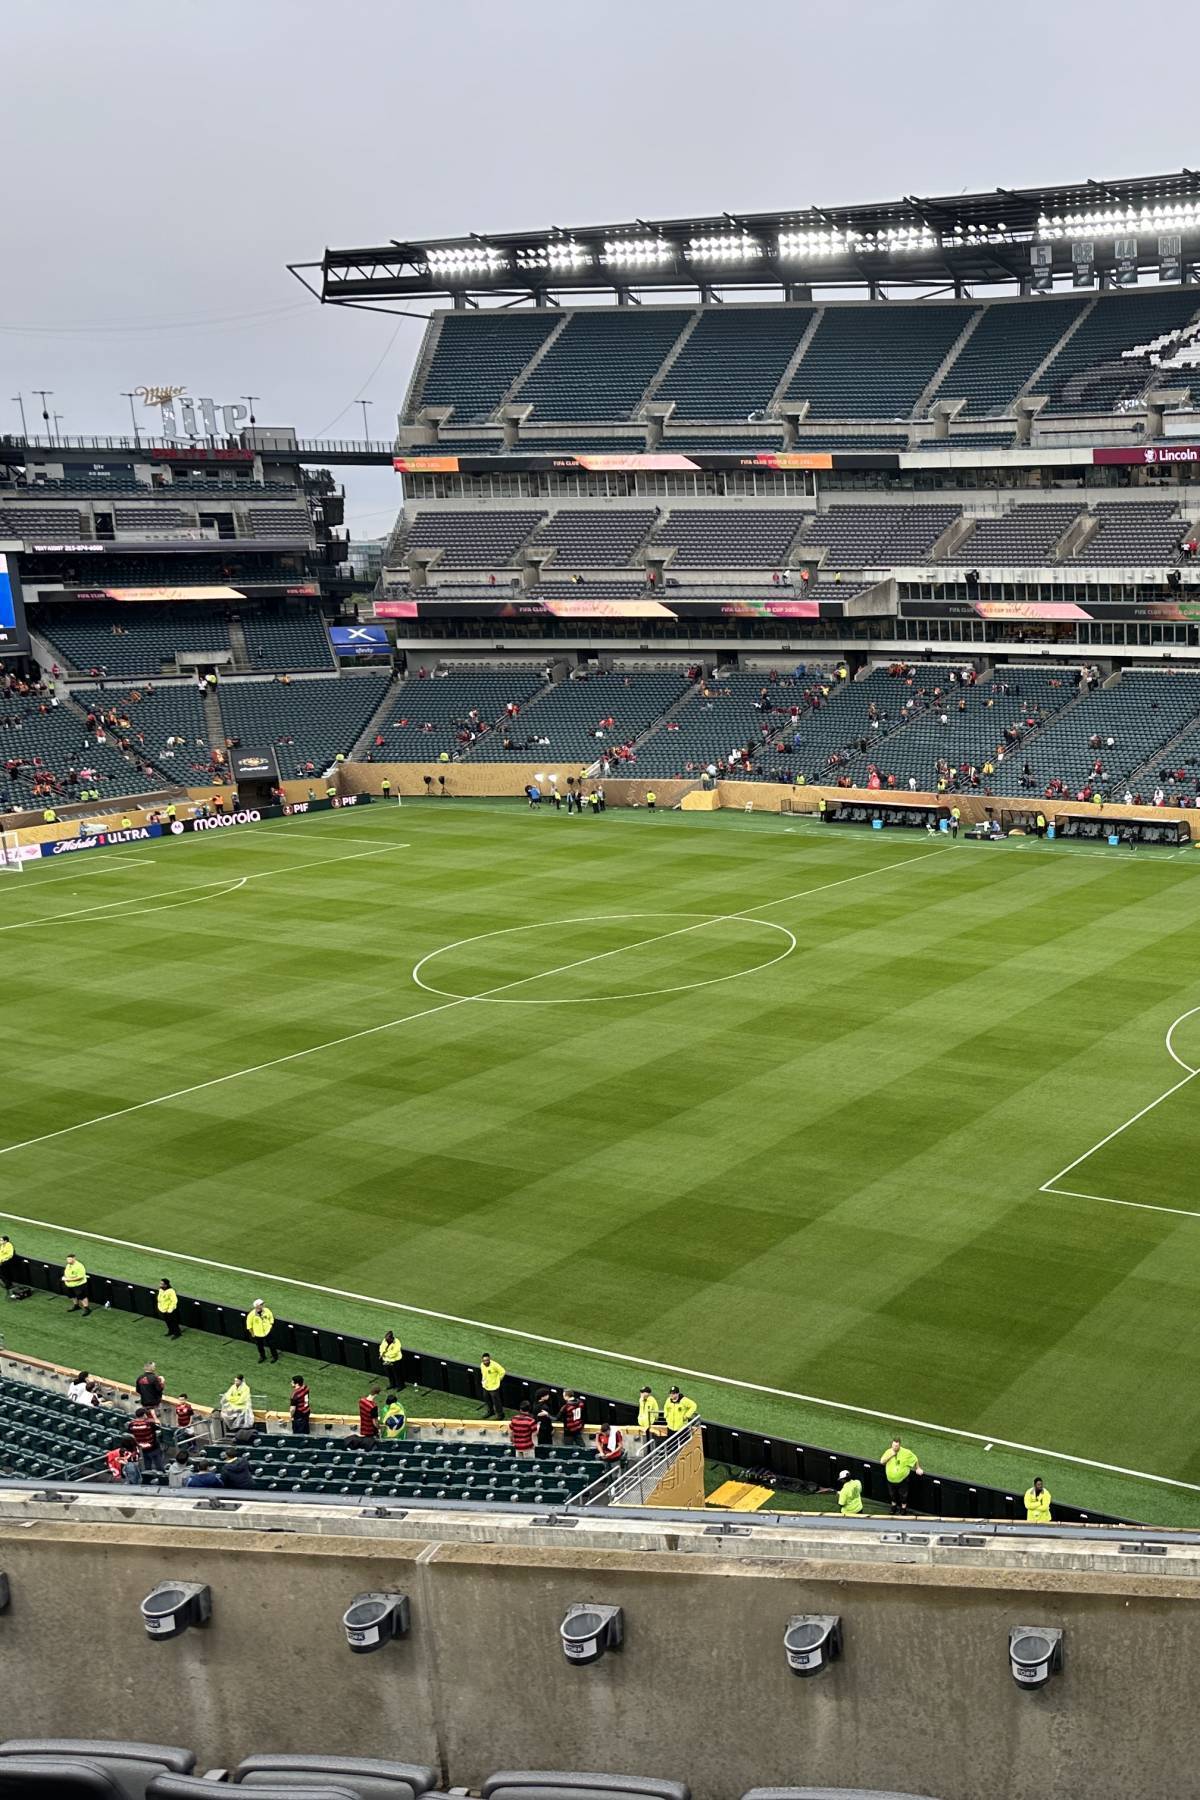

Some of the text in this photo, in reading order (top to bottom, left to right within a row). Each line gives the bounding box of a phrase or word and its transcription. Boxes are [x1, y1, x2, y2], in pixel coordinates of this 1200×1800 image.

[135, 385, 187, 406] Miller
[161, 397, 248, 446] Lite
[1159, 449, 1198, 461] Lincoln
[293, 802, 309, 814] PIF
[342, 795, 358, 807] PIF
[193, 809, 261, 832] motorola
[107, 827, 150, 844] ULTRA
